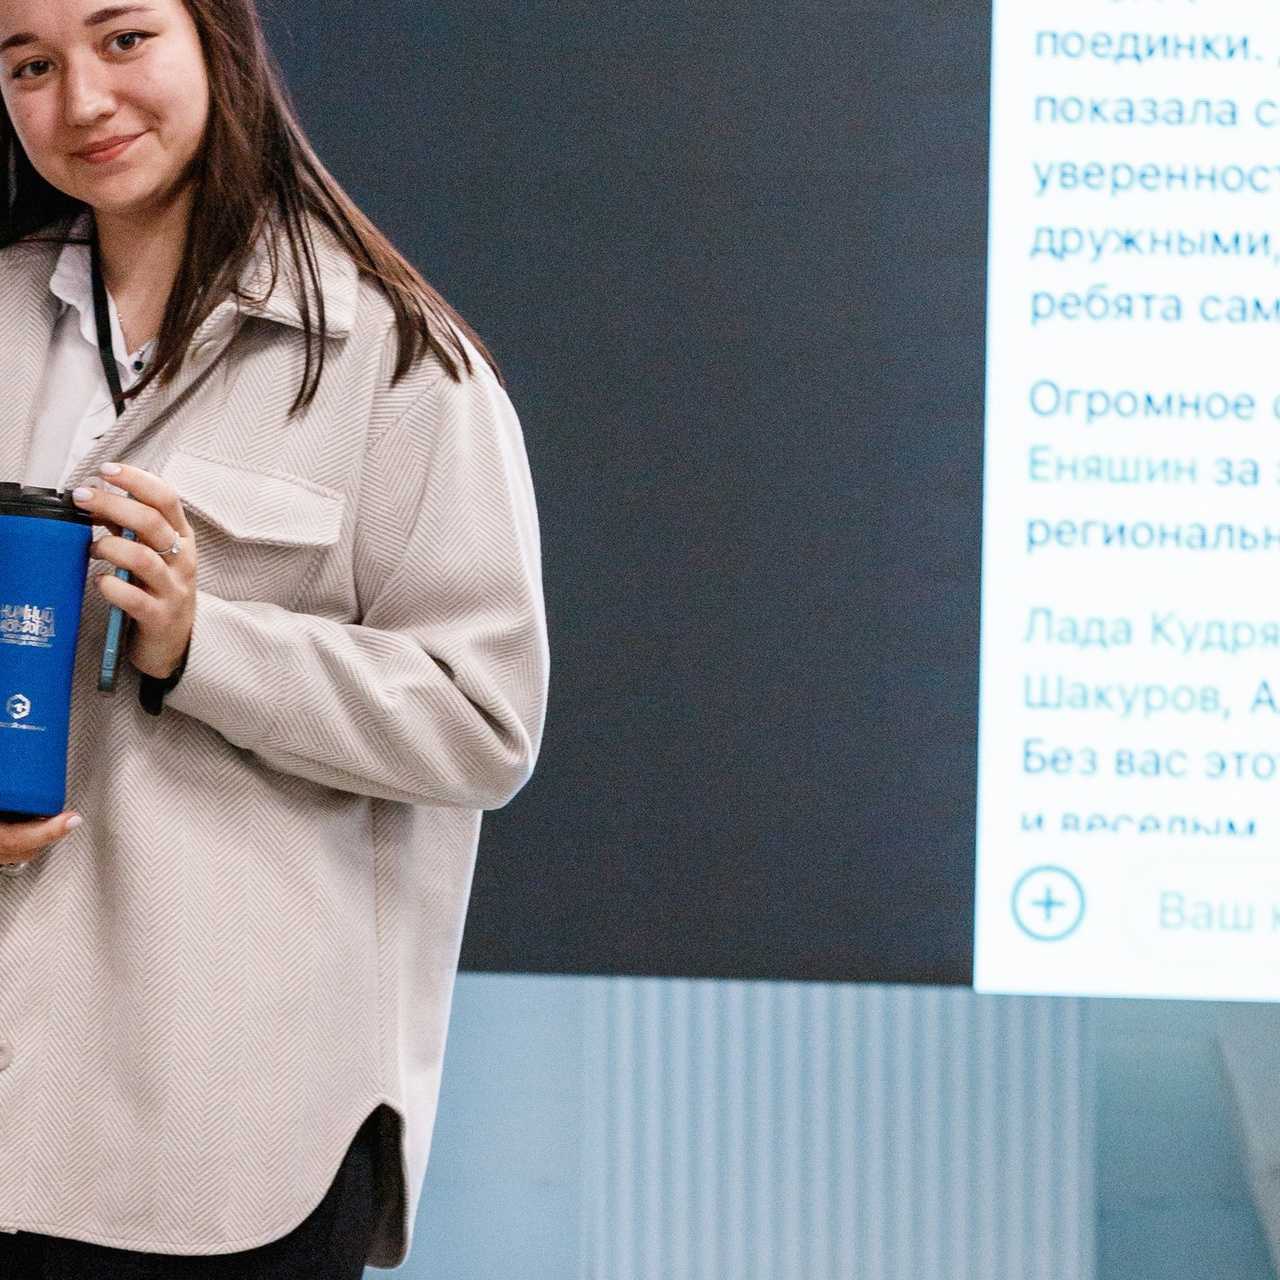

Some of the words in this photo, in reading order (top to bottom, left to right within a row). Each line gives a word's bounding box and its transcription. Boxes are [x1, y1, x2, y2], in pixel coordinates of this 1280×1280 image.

[1035, 30, 1262, 64] поединки.
[1034, 95, 1238, 127] показала
[1030, 283, 1183, 326] ребята
[1028, 379, 1257, 425] Огромное
[1028, 444, 1198, 485] Еняшин
[1214, 457, 1260, 487] за
[1023, 606, 1134, 651] Лада
[1023, 673, 1231, 721] Шакуров,
[1022, 737, 1098, 776] Без
[1114, 749, 1187, 778] вас
[1158, 889, 1255, 933] Ваш
